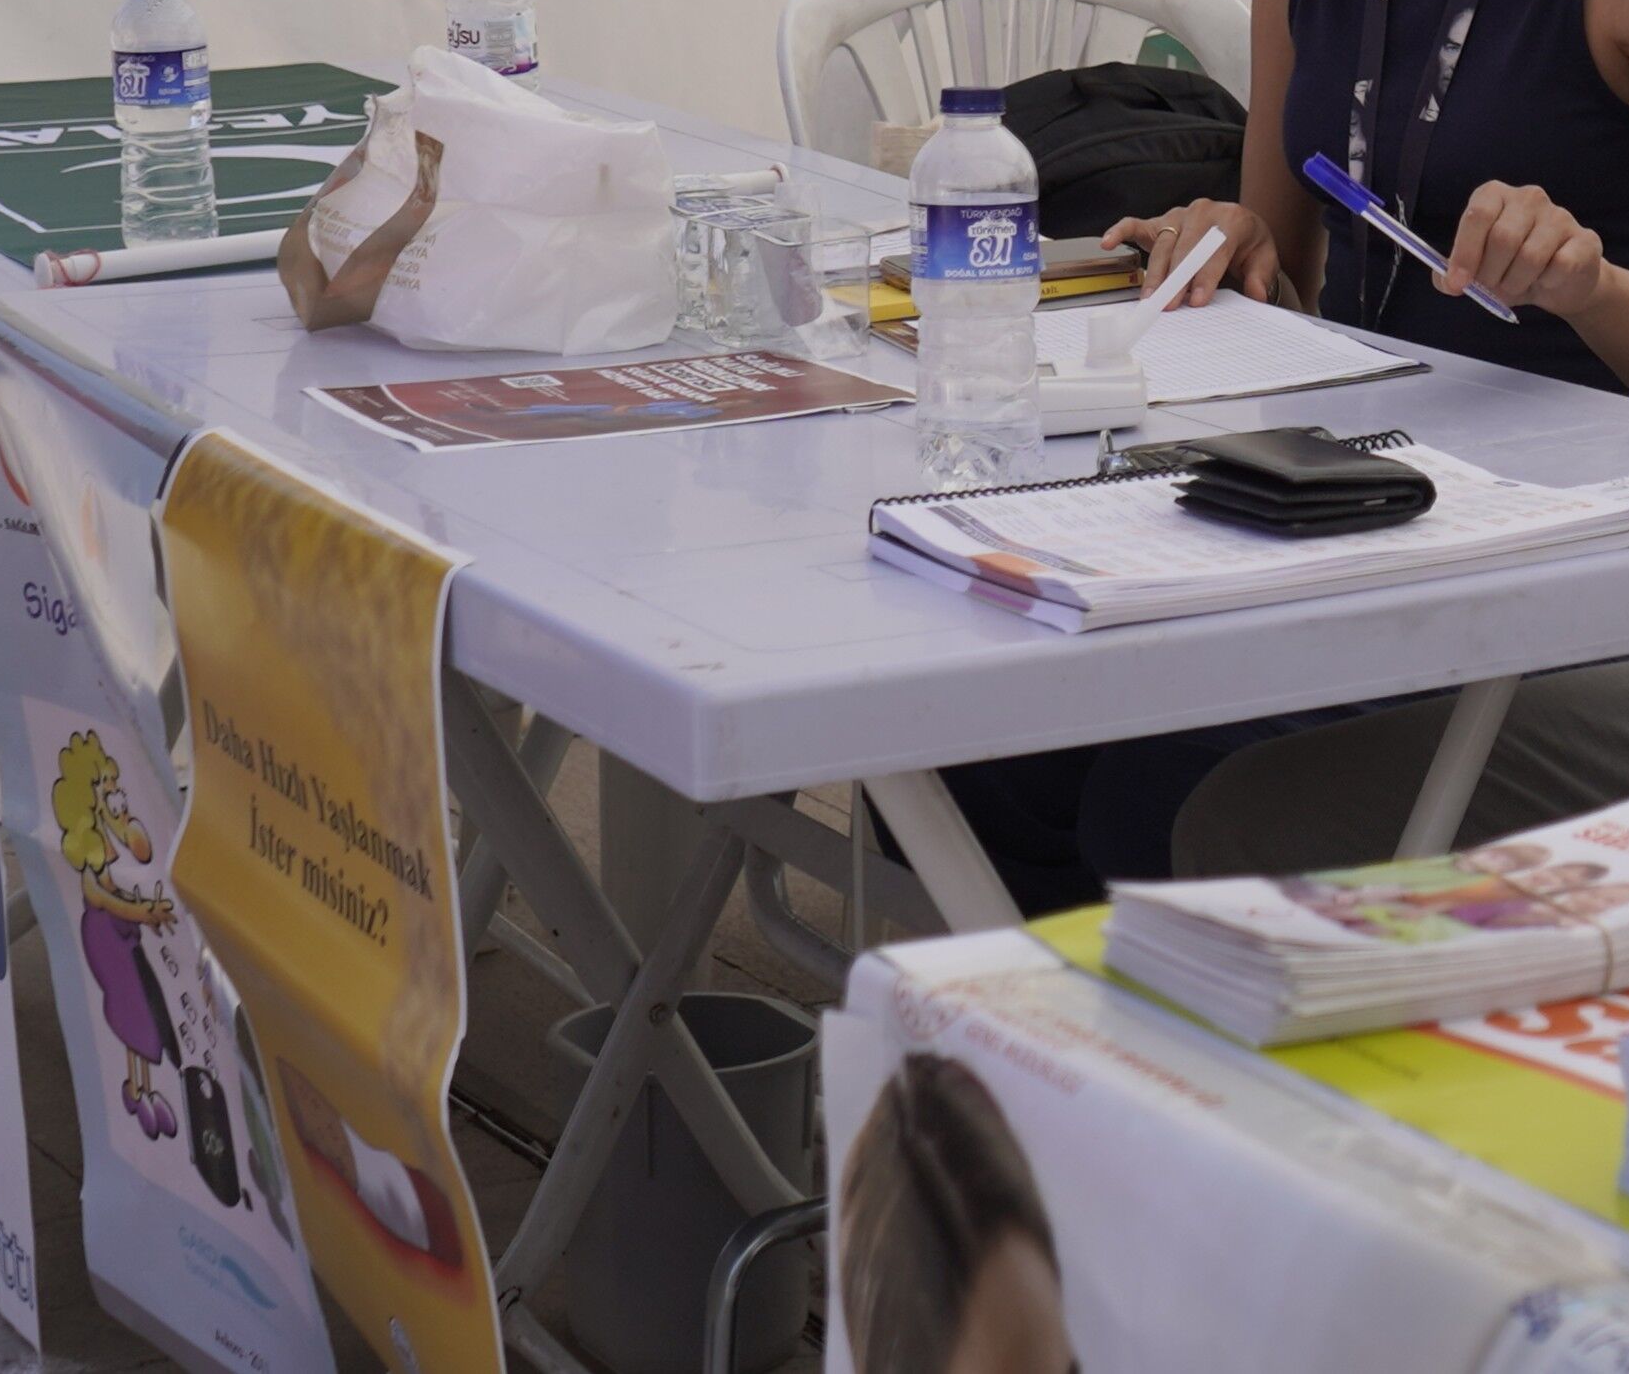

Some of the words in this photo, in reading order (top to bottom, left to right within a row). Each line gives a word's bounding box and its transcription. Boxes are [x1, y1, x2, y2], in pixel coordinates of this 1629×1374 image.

[202, 698, 255, 773] Daha
[258, 737, 309, 814] Hızlı
[309, 772, 434, 902] Yaşlanmak
[248, 792, 297, 876] İster
[301, 855, 390, 949] misiniz?
